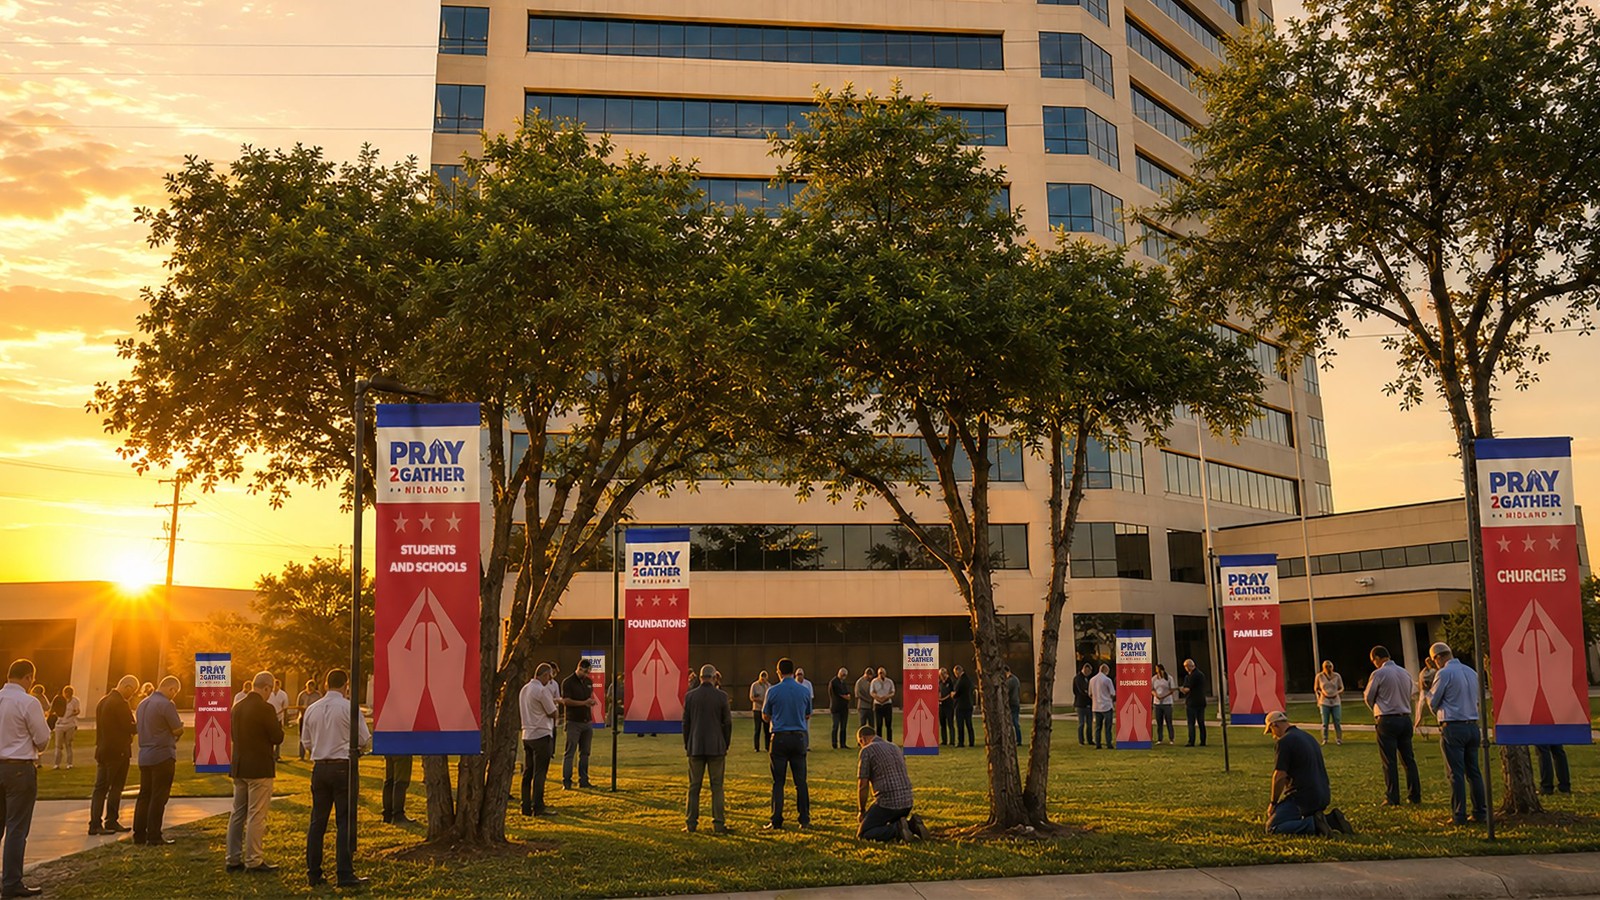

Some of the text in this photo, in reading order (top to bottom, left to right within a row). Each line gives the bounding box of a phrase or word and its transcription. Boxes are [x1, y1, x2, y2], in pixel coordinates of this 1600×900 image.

[390, 438, 464, 465] PRAY
[390, 467, 464, 482] 2GATHER
[1490, 469, 1560, 494] PRAY
[1491, 494, 1561, 509] 2GATHER
[401, 544, 456, 555] STUDENTS
[633, 550, 680, 566] PRAY
[390, 562, 467, 572] AND SCHOOLS
[633, 567, 680, 577] 2GATHER
[1228, 572, 1268, 586] PRAY
[1497, 568, 1566, 583] CHURCHES
[1229, 586, 1270, 596] 2GATHER
[628, 619, 686, 628] FOUNDATIONS
[1233, 629, 1273, 637] FAMILIES
[1121, 641, 1146, 650] PRAY
[908, 647, 934, 656] PRAY
[200, 665, 226, 674] PRAY
